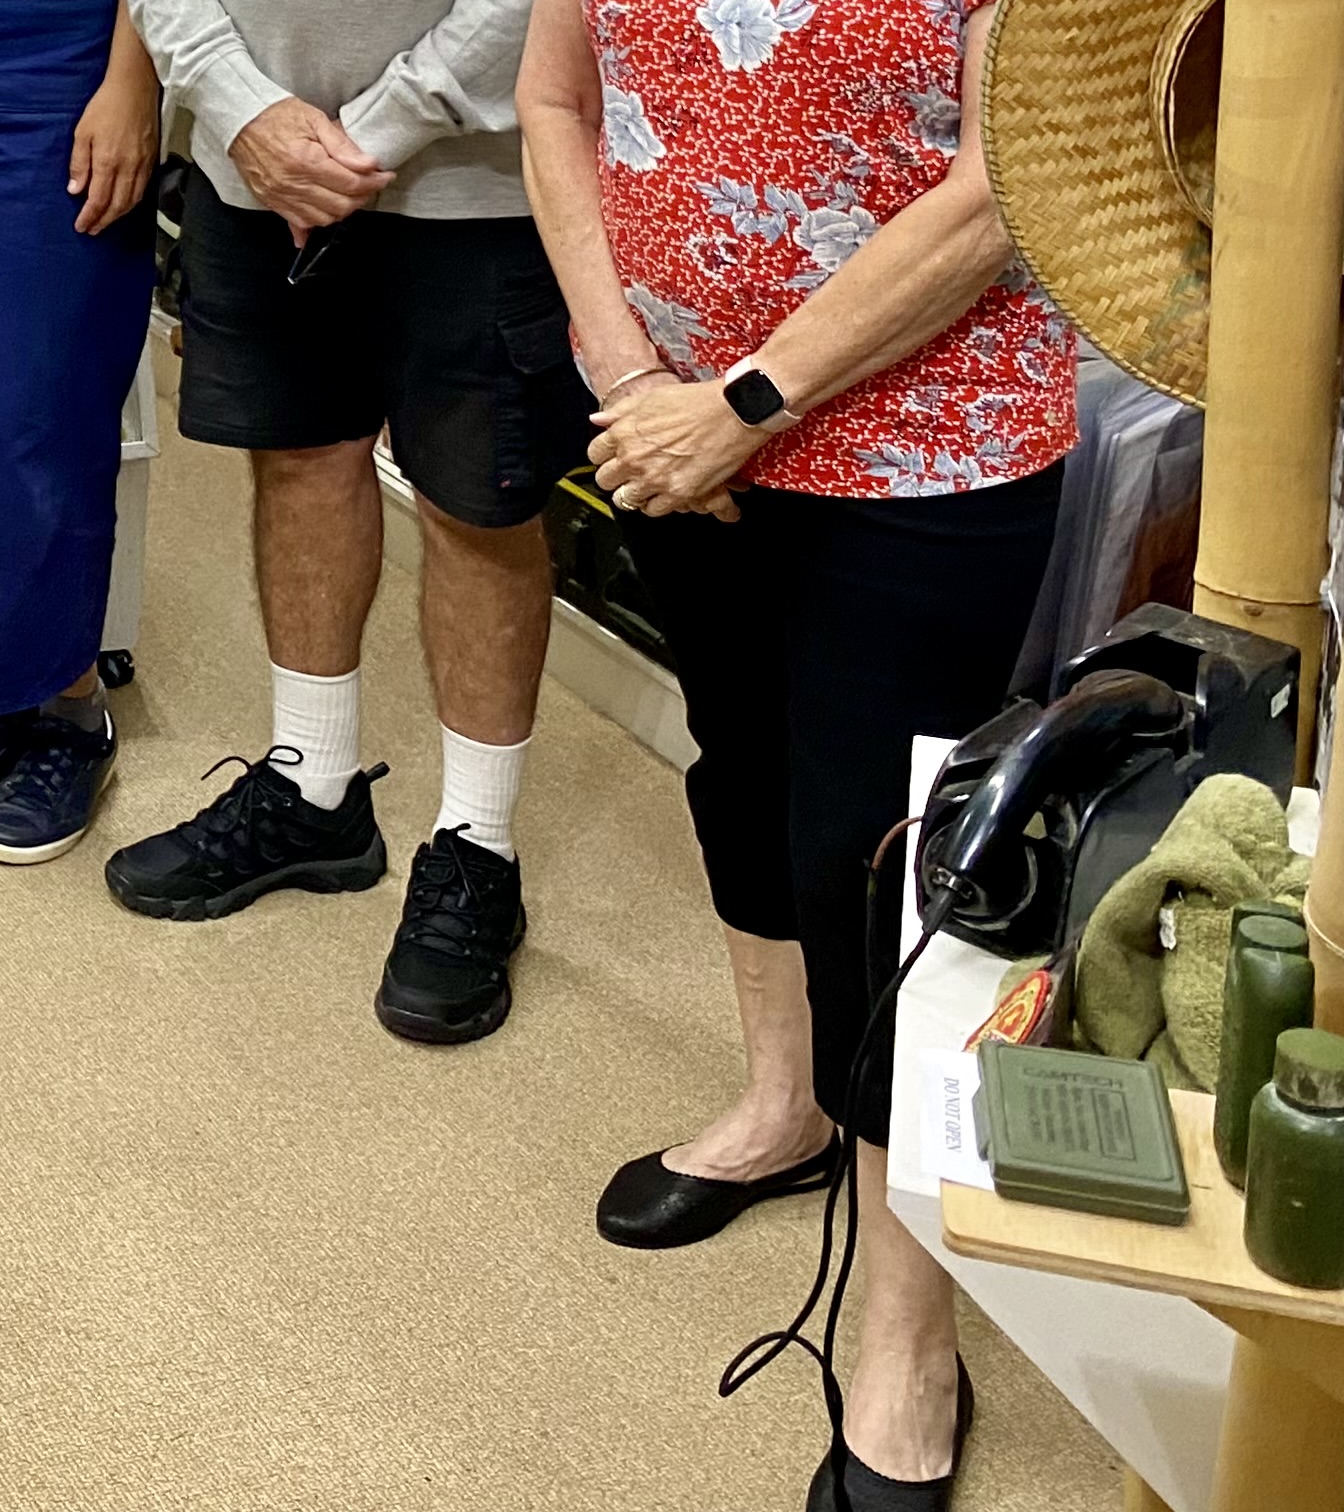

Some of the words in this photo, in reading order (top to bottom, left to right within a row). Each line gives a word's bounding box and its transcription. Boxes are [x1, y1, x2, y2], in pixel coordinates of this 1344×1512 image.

[944, 1076, 960, 1095] DO
[944, 1098, 961, 1118] NOT
[944, 1121, 962, 1153] OPEN
